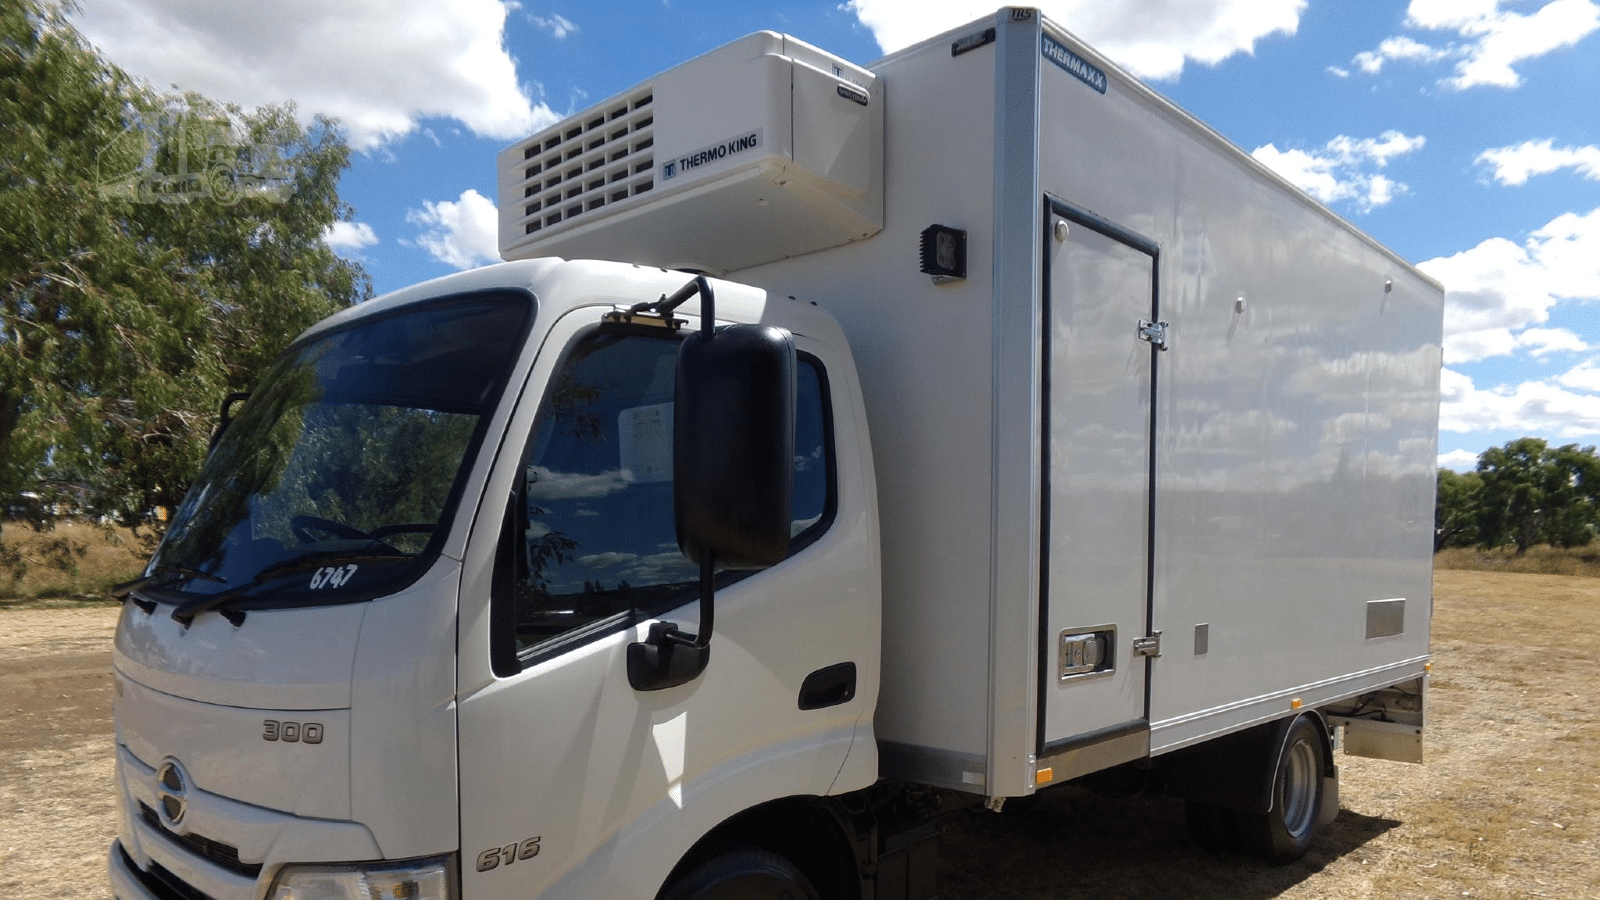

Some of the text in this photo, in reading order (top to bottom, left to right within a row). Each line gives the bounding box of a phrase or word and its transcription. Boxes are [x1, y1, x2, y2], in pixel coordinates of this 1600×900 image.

[1043, 38, 1104, 88] THERMAXX
[679, 144, 727, 171] THERMO
[728, 133, 757, 155] KING
[309, 563, 358, 590] 6747
[262, 719, 324, 744] 300
[476, 836, 541, 872] 616
